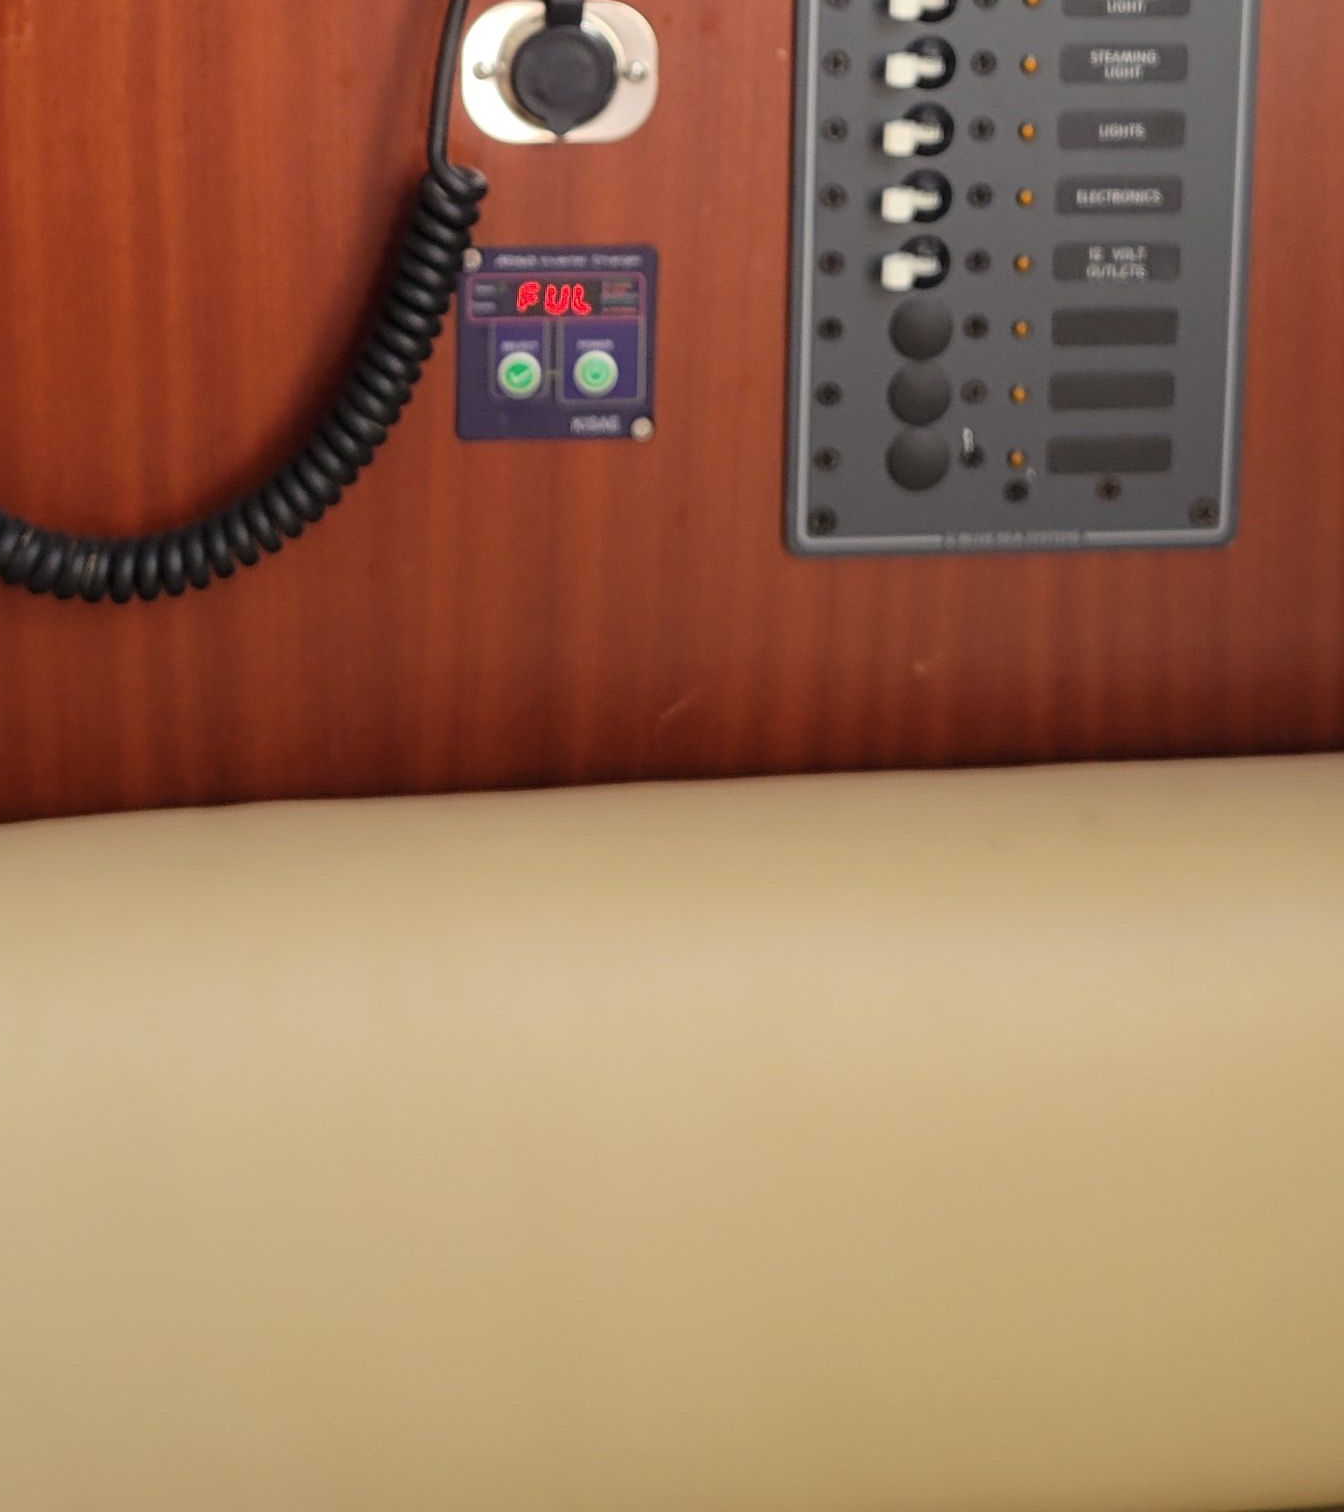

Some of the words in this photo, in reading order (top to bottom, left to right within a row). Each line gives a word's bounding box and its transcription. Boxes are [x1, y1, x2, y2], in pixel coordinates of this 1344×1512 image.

[1106, 0, 1146, 14] LIGHT
[1089, 48, 1160, 65] STEAMING
[1104, 64, 1142, 79] LIGHT
[1099, 122, 1146, 139] LIGHTS
[1076, 188, 1163, 205] ELECTRONICS
[1086, 262, 1147, 280] OUTLETS
[516, 280, 592, 316] FUL
